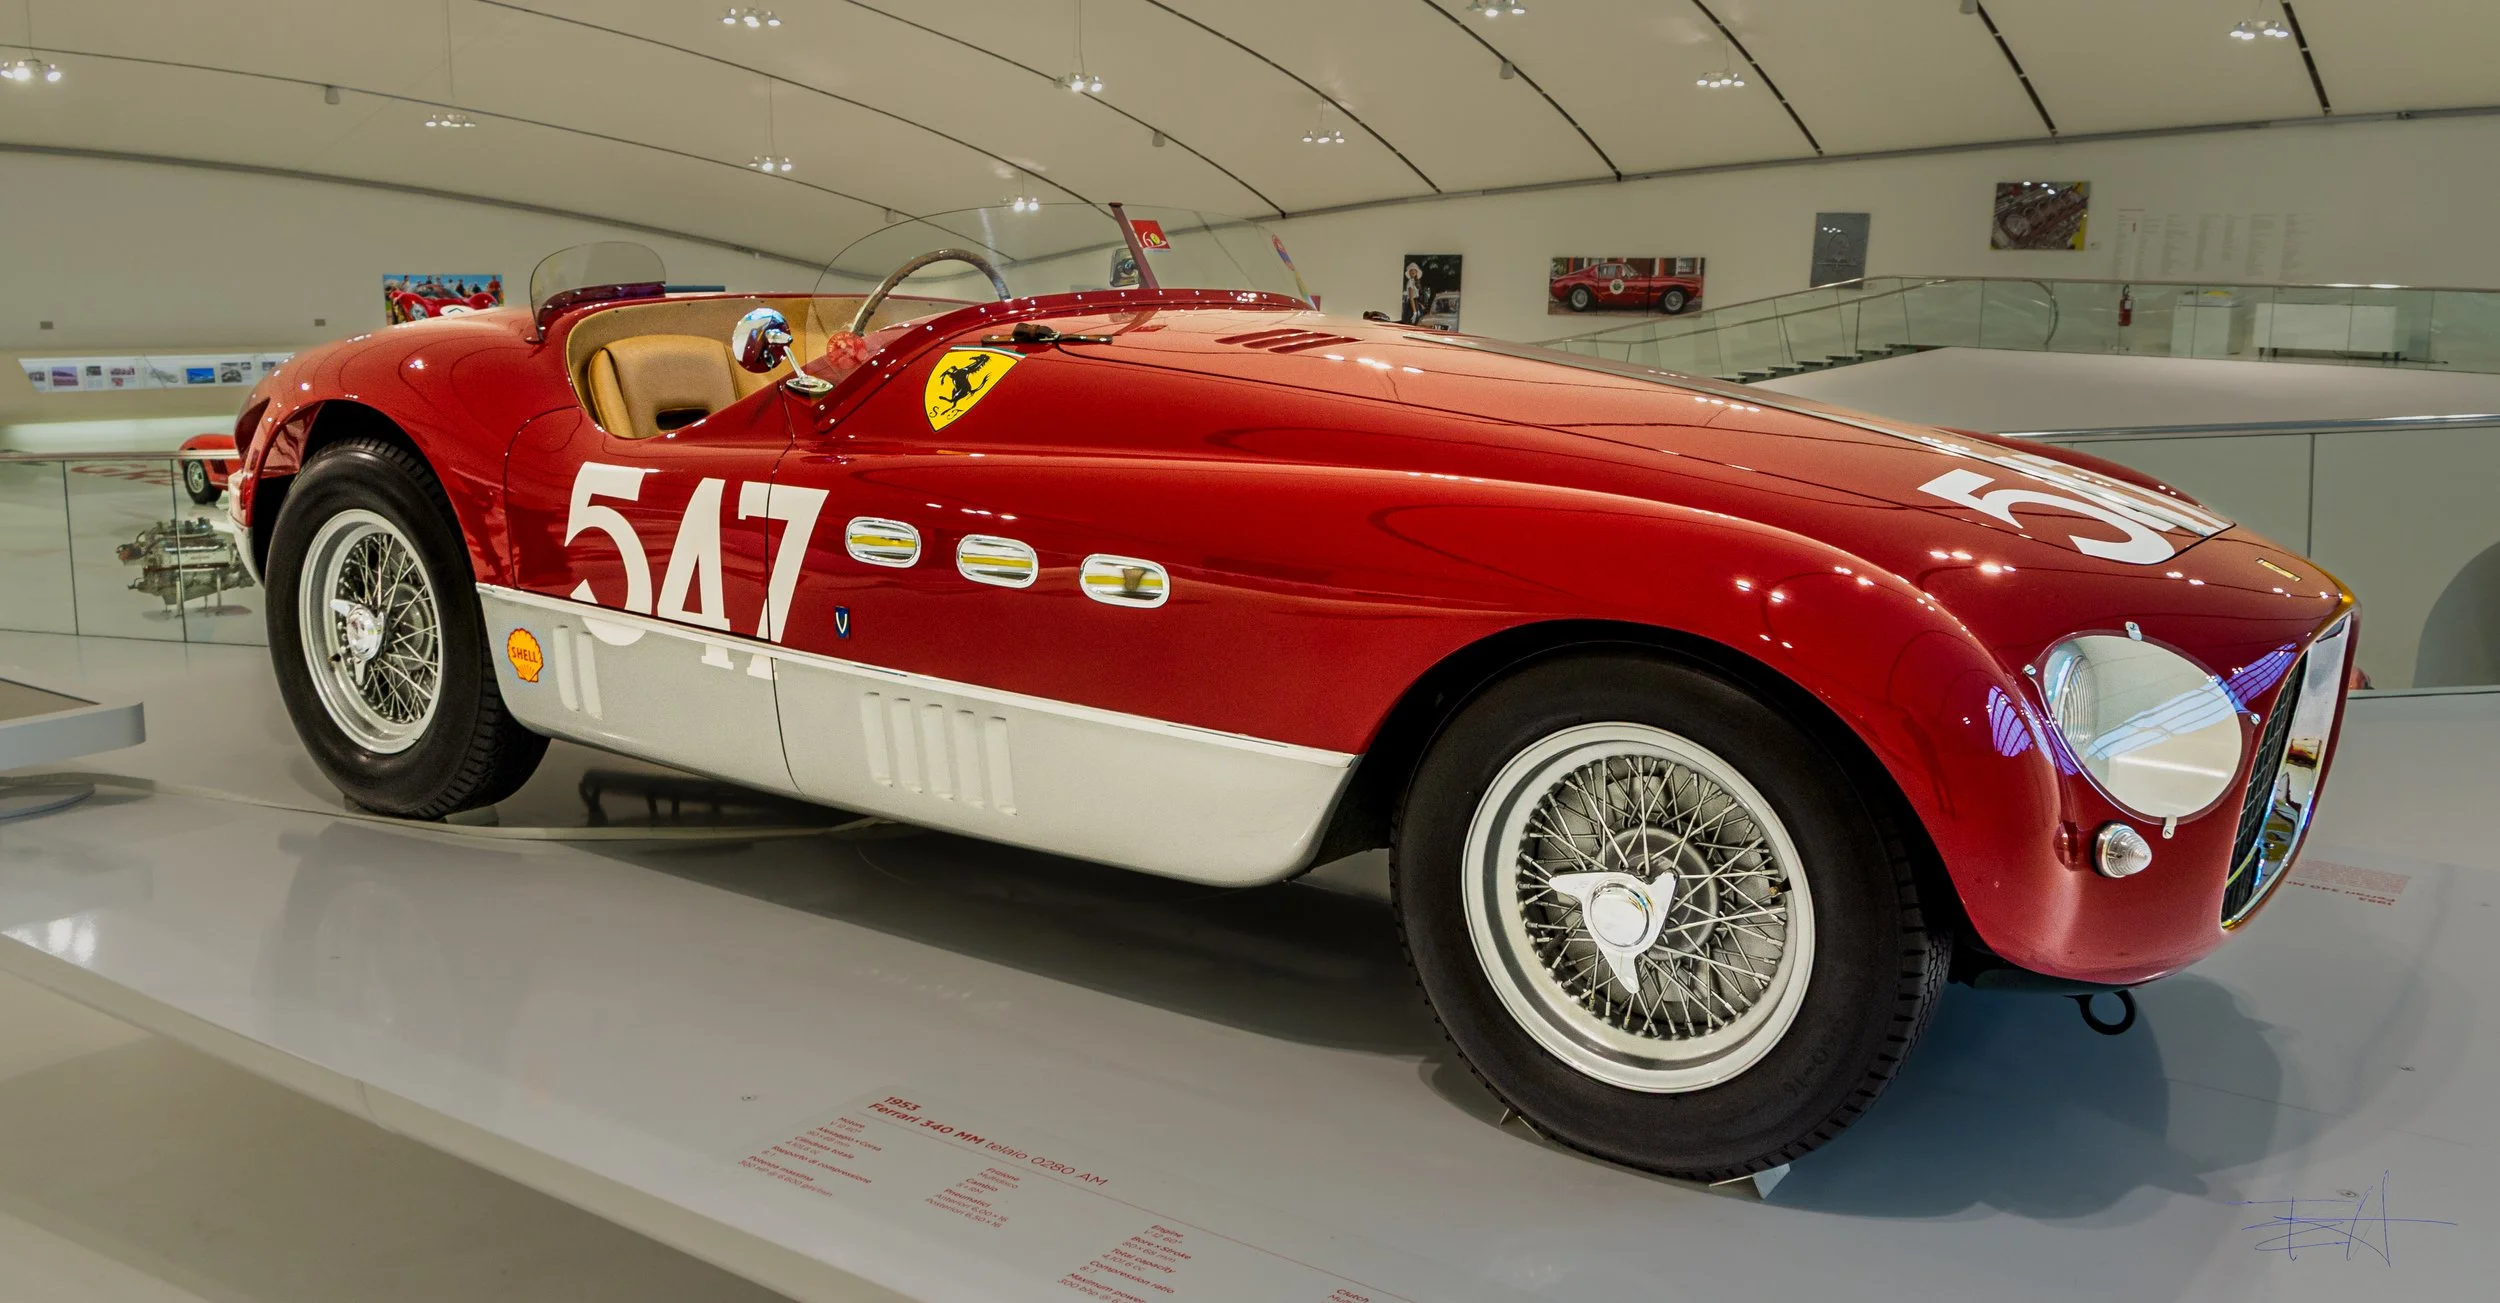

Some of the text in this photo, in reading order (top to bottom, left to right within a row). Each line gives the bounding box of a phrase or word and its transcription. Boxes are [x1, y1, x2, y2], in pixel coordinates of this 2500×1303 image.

[564, 461, 830, 680] 547
[511, 646, 539, 664] SHELL
[884, 1096, 922, 1112] 1953
[867, 1102, 1110, 1187] Ferrari 340 MM telaio 0280 AM
[966, 1178, 998, 1192] Cambio
[944, 1187, 992, 1208] Pneumatici
[1151, 1224, 1184, 1238] Engine
[1130, 1236, 1154, 1247] Bore
[1160, 1246, 1192, 1260] Stroke
[1112, 1247, 1177, 1274] Total capacity
[1066, 1272, 1114, 1292] Maximum
[1089, 1260, 1175, 1294] Compression ratio
[1336, 1288, 1369, 1303] Clutch
